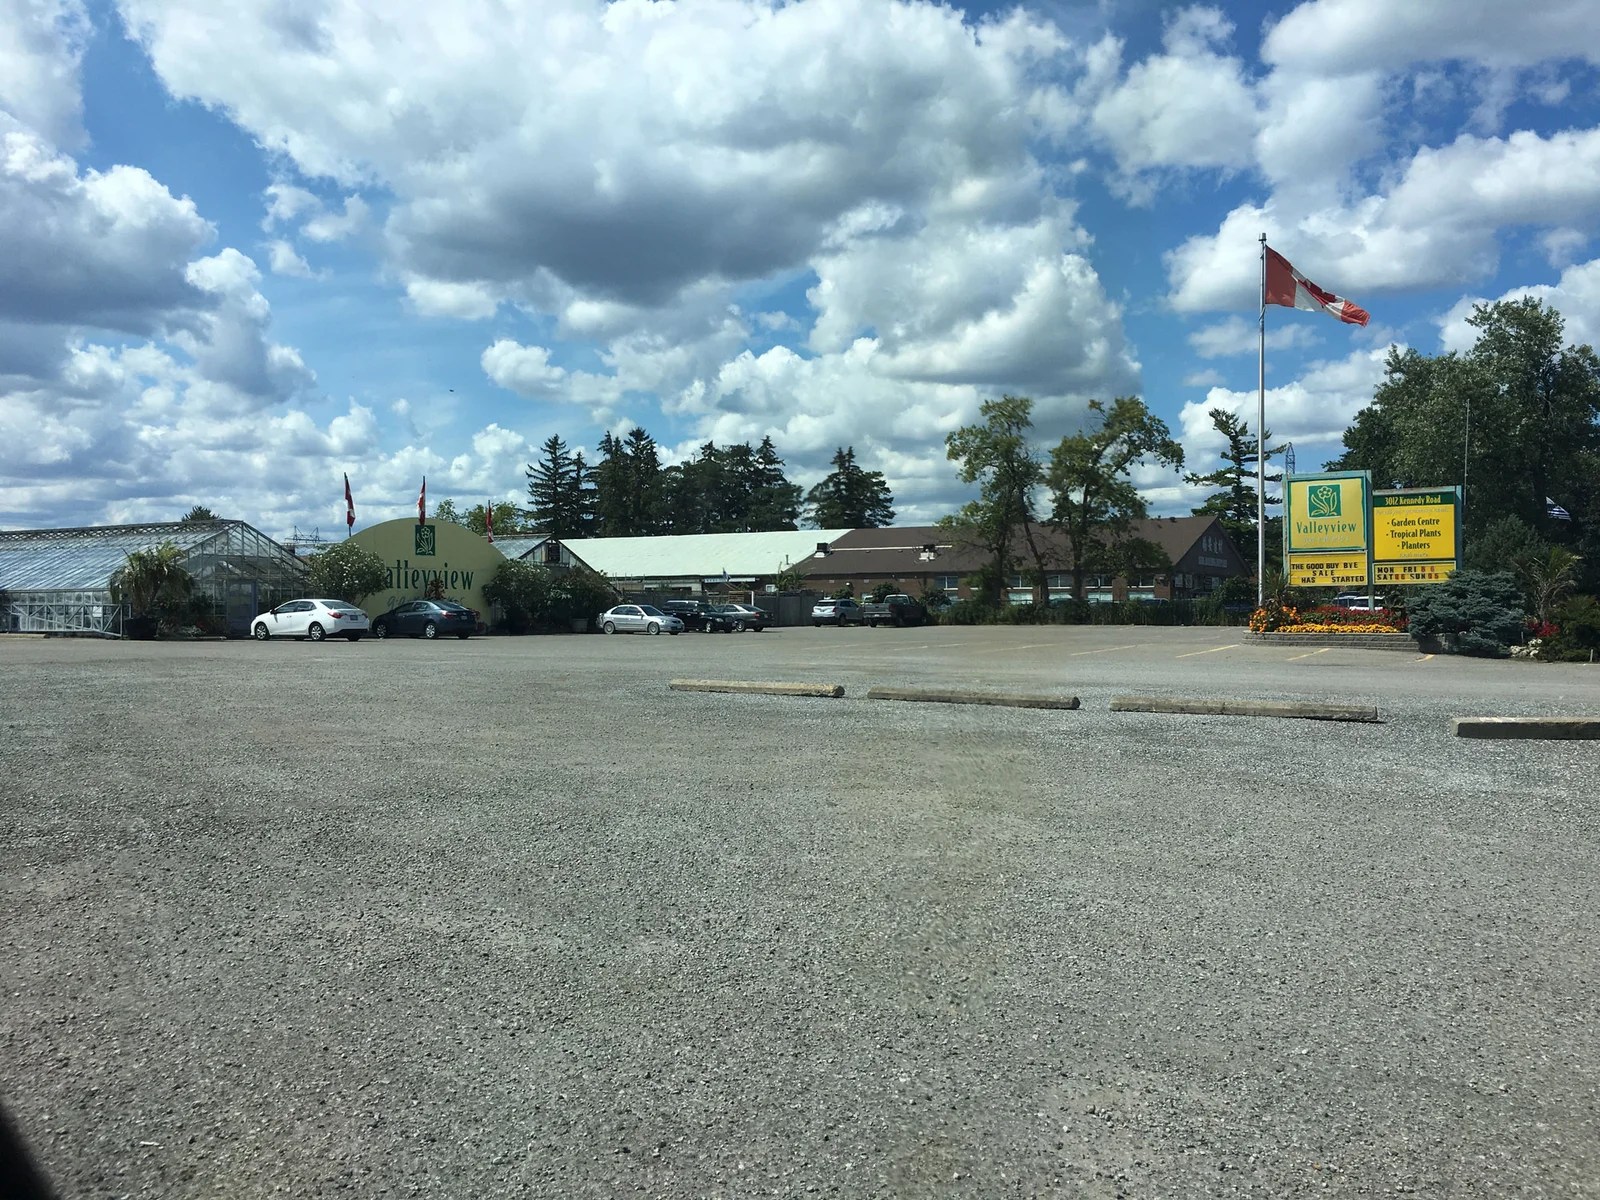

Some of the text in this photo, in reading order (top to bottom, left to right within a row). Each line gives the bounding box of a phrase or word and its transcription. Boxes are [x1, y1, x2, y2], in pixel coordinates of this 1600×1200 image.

[1385, 495, 1441, 505] 3012 Kennedy Road
[1391, 517, 1440, 526] Garden Centre
[1296, 521, 1357, 534] Valleyview
[1390, 529, 1441, 539] Tropical Plants
[1401, 541, 1430, 549] Planters
[385, 560, 474, 592] alleyview
